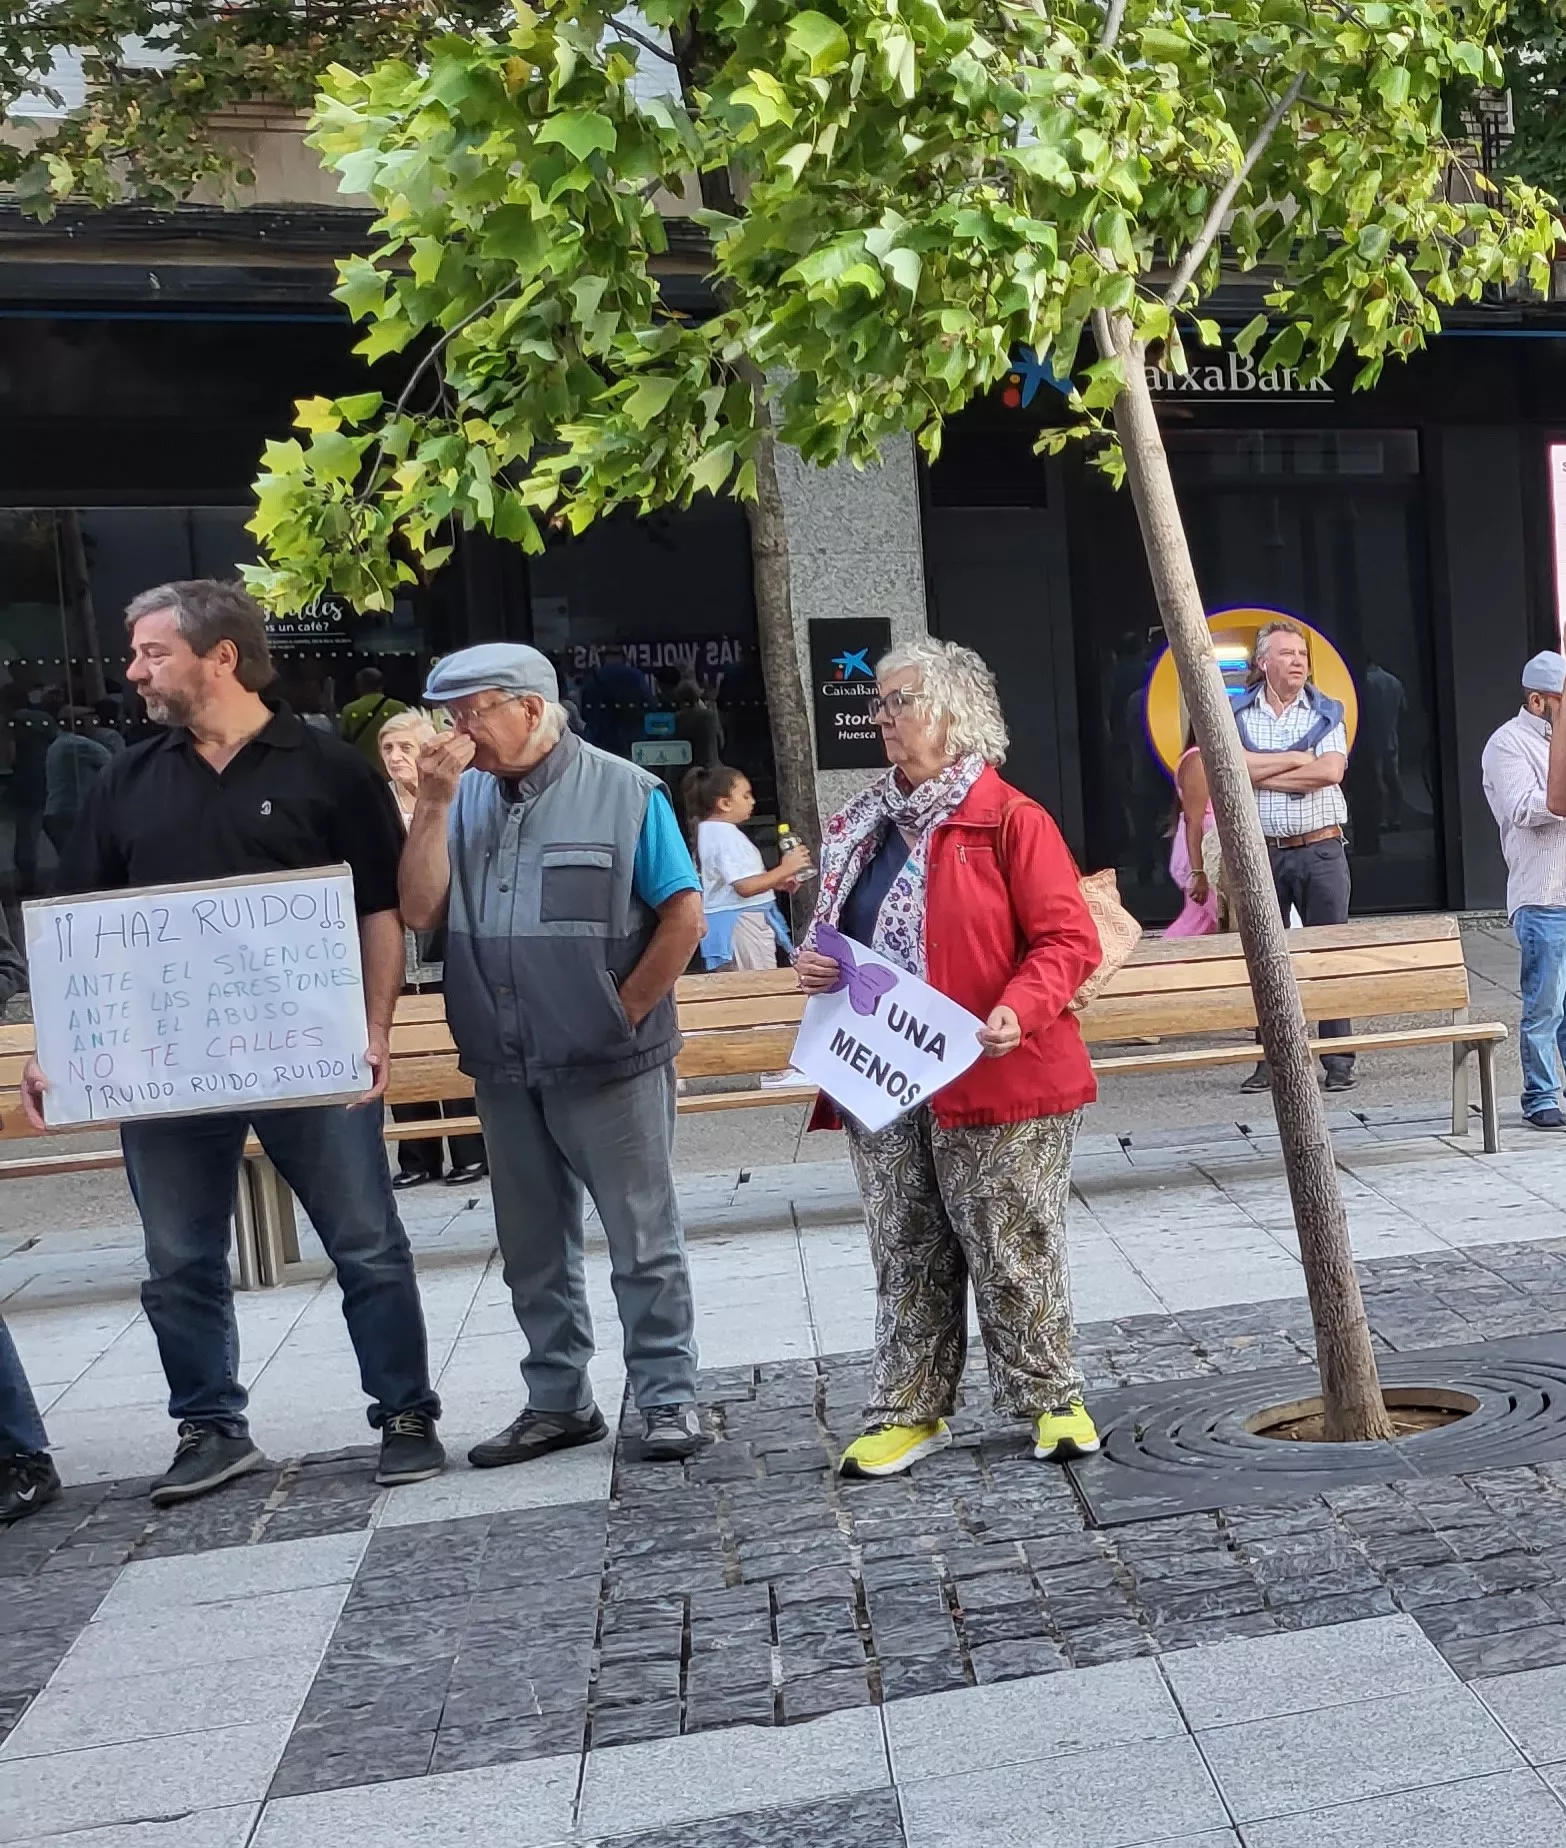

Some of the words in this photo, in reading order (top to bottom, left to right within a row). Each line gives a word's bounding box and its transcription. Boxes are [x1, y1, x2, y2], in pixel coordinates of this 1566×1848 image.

[279, 623, 295, 632] un
[298, 621, 329, 632] café?
[822, 683, 879, 697] CaixaBan
[838, 730, 877, 740] Huesca
[95, 908, 181, 958] HAZ
[64, 972, 133, 999] ANTE
[162, 961, 193, 984] EL
[69, 1001, 132, 1031] ANTE
[151, 990, 191, 1012] LAS
[73, 1028, 132, 1054] ANTE
[157, 1014, 184, 1036] EL
[206, 1000, 299, 1029] ABUSO
[887, 1002, 947, 1062] UNA
[67, 1053, 114, 1083] NO
[140, 1042, 180, 1070] TE
[206, 1026, 325, 1058] CALLES
[273, 1053, 360, 1083] RUIDO!
[829, 1027, 921, 1107] MENOS
